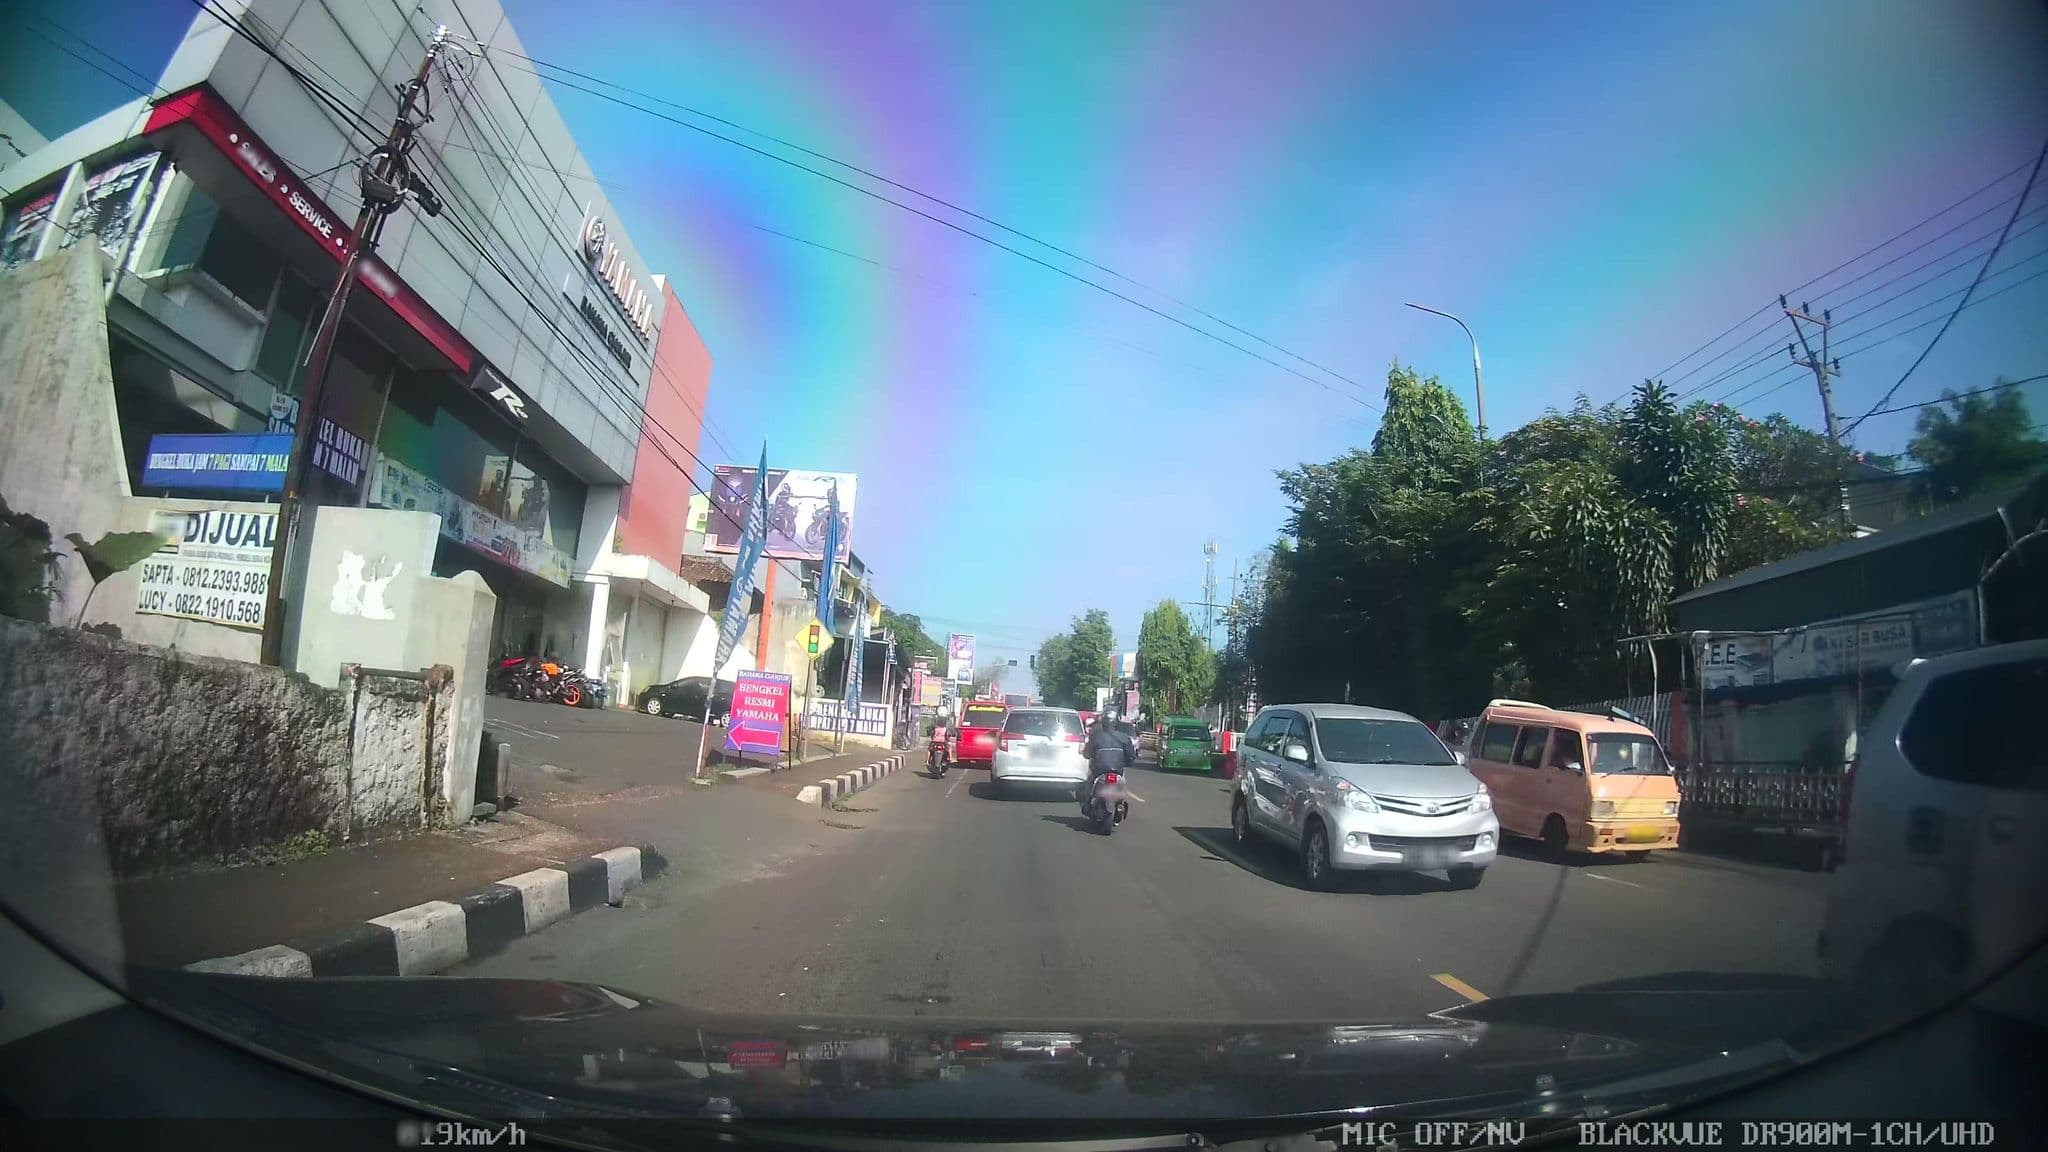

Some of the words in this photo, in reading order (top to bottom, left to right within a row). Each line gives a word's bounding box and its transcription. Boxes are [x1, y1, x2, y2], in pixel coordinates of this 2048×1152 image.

[289, 192, 333, 238] SERVICE
[265, 455, 289, 472] MALA
[183, 512, 275, 548] DIJUAL
[142, 564, 174, 584] SAPTA
[139, 590, 167, 610] LUCY
[175, 593, 261, 624] 0822.1910.568
[740, 683, 784, 696] BENGKEL
[744, 696, 775, 708] RESMI
[736, 708, 779, 721] YAMAHA
